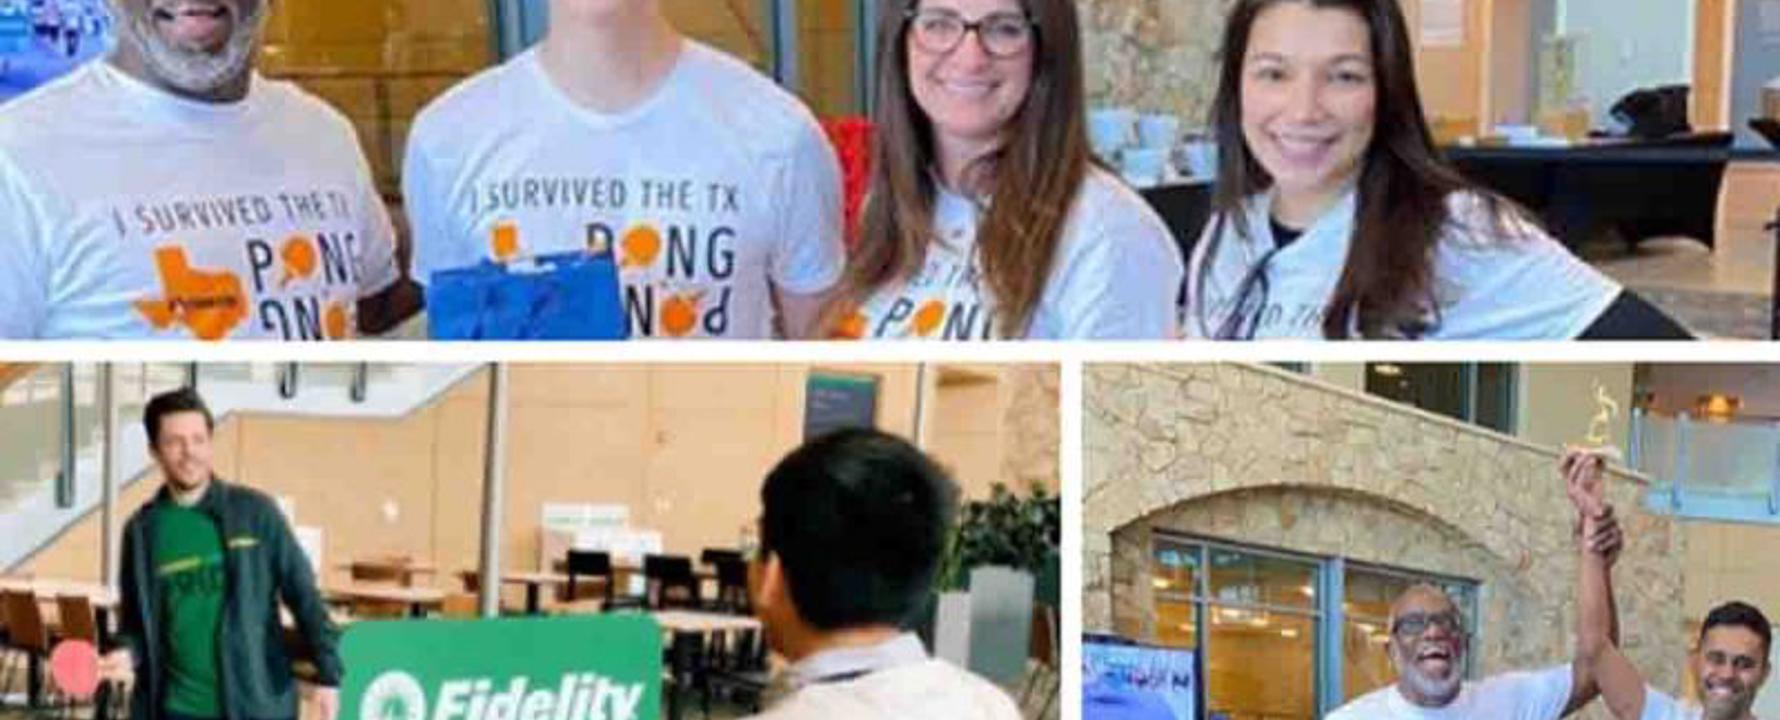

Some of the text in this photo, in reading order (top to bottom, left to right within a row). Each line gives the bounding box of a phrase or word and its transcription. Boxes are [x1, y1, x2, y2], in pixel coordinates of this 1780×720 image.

[113, 206, 126, 237] I
[135, 195, 272, 234] SURVIVED
[277, 192, 324, 219] THE
[487, 177, 626, 211] SURVIVED
[640, 179, 693, 210] THE
[708, 183, 740, 213] TX
[433, 672, 646, 720] Fidelity
